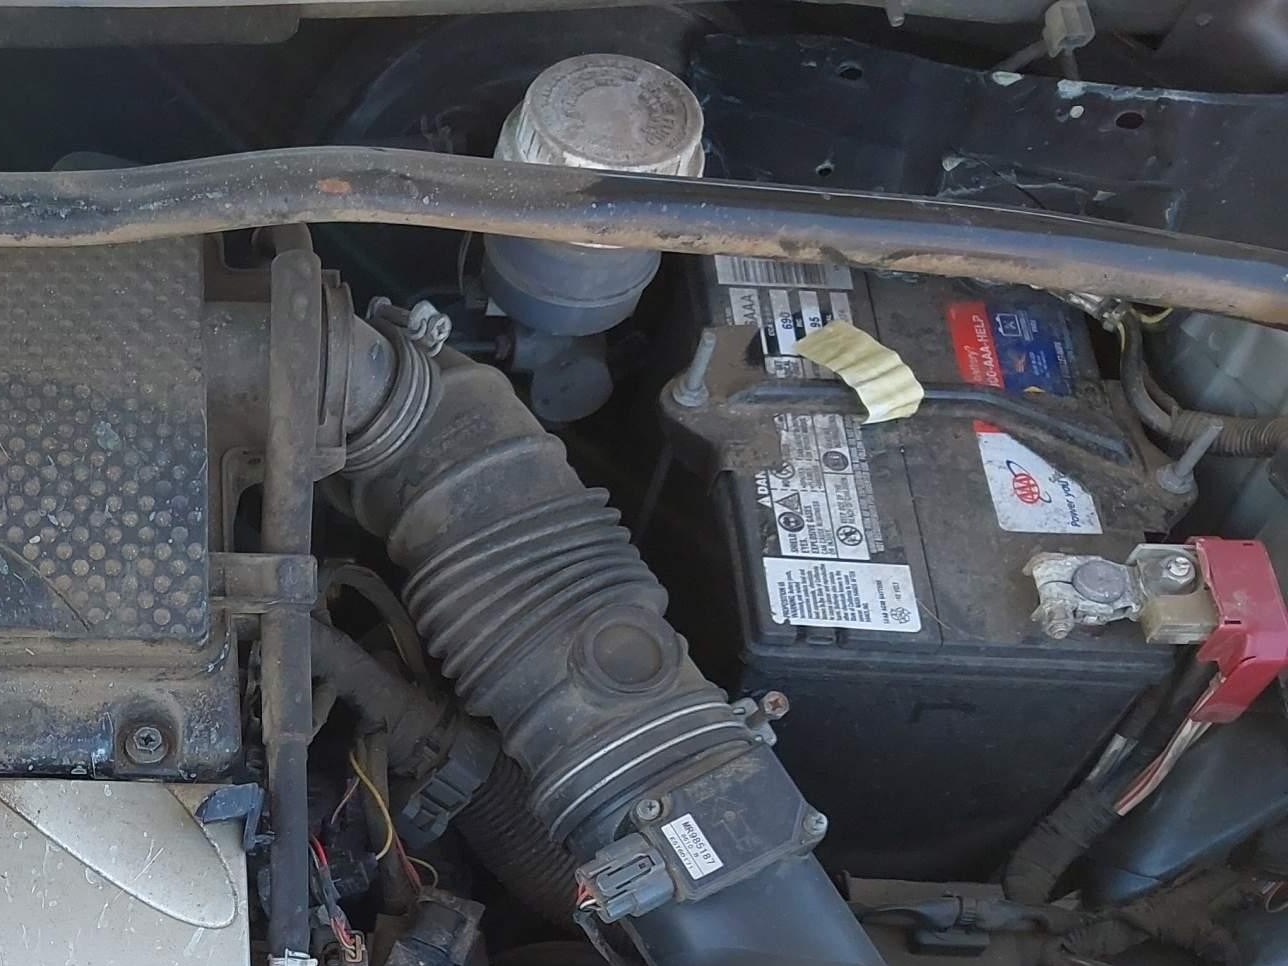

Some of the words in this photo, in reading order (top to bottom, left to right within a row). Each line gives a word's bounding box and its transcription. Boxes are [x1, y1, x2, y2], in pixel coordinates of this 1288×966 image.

[779, 312, 793, 330] 690
[808, 316, 821, 328] 95
[1065, 498, 1080, 527] Power
[682, 821, 716, 865] MR985187
